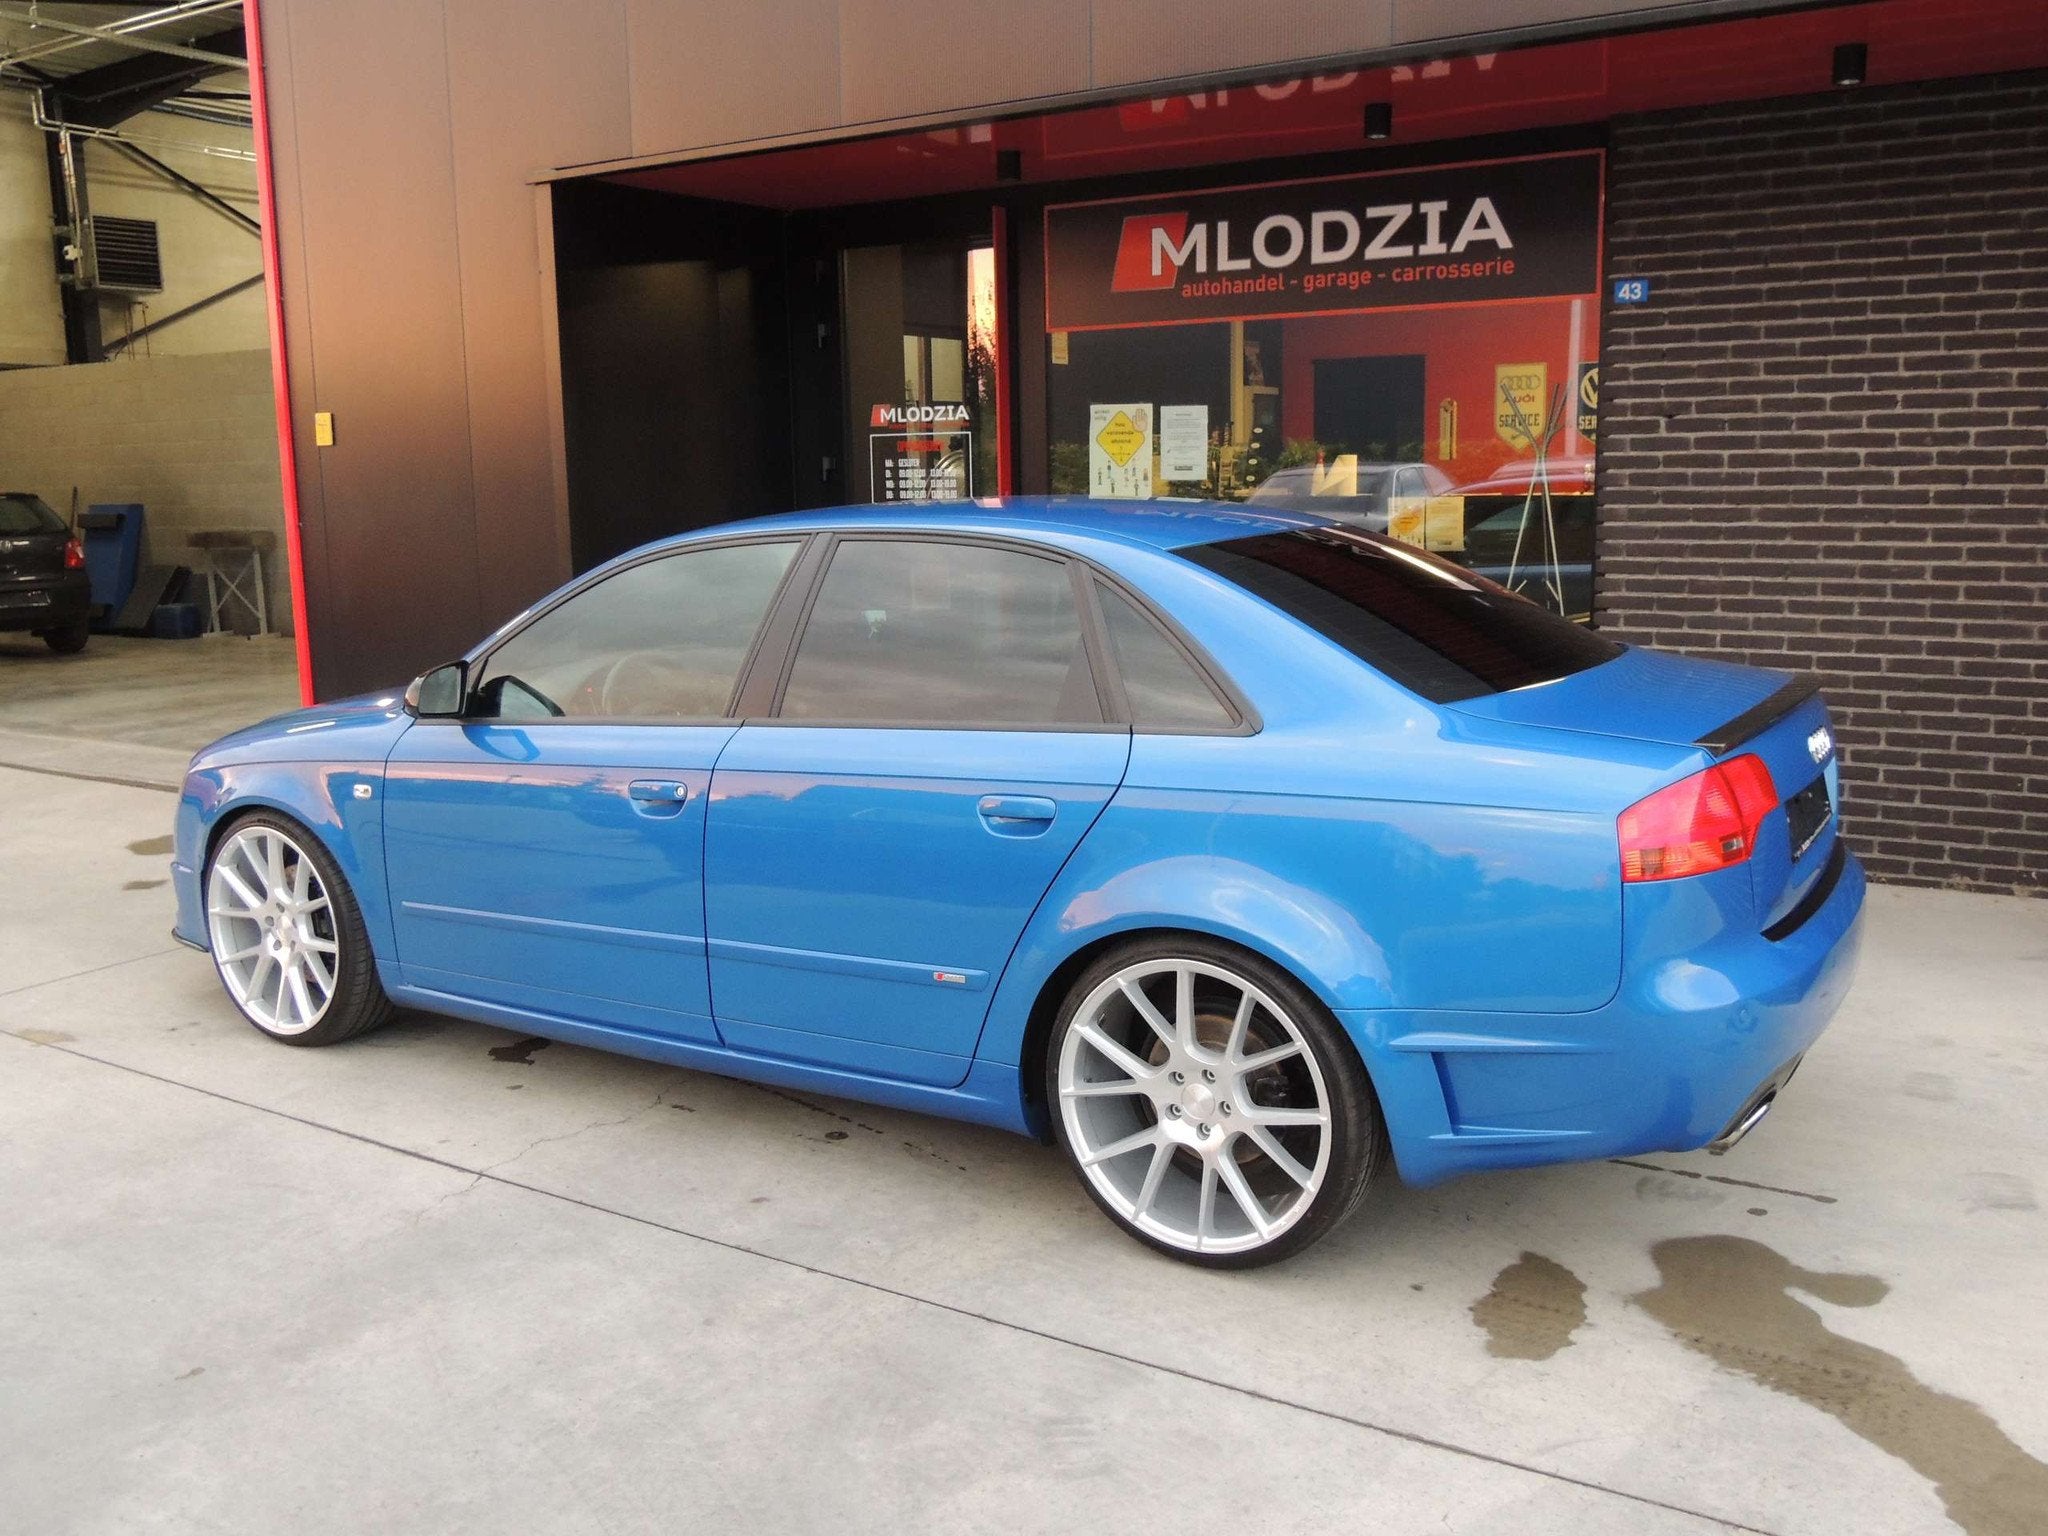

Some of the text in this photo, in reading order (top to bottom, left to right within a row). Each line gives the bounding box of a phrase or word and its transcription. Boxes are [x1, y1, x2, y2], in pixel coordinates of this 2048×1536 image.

[1151, 196, 1514, 277] MLODZIA
[1181, 273, 1285, 298] autohandel
[1302, 270, 1373, 294] garage
[1391, 257, 1516, 283] carrosserie
[1618, 283, 1642, 300] 43
[880, 405, 970, 423] MLODZIA
